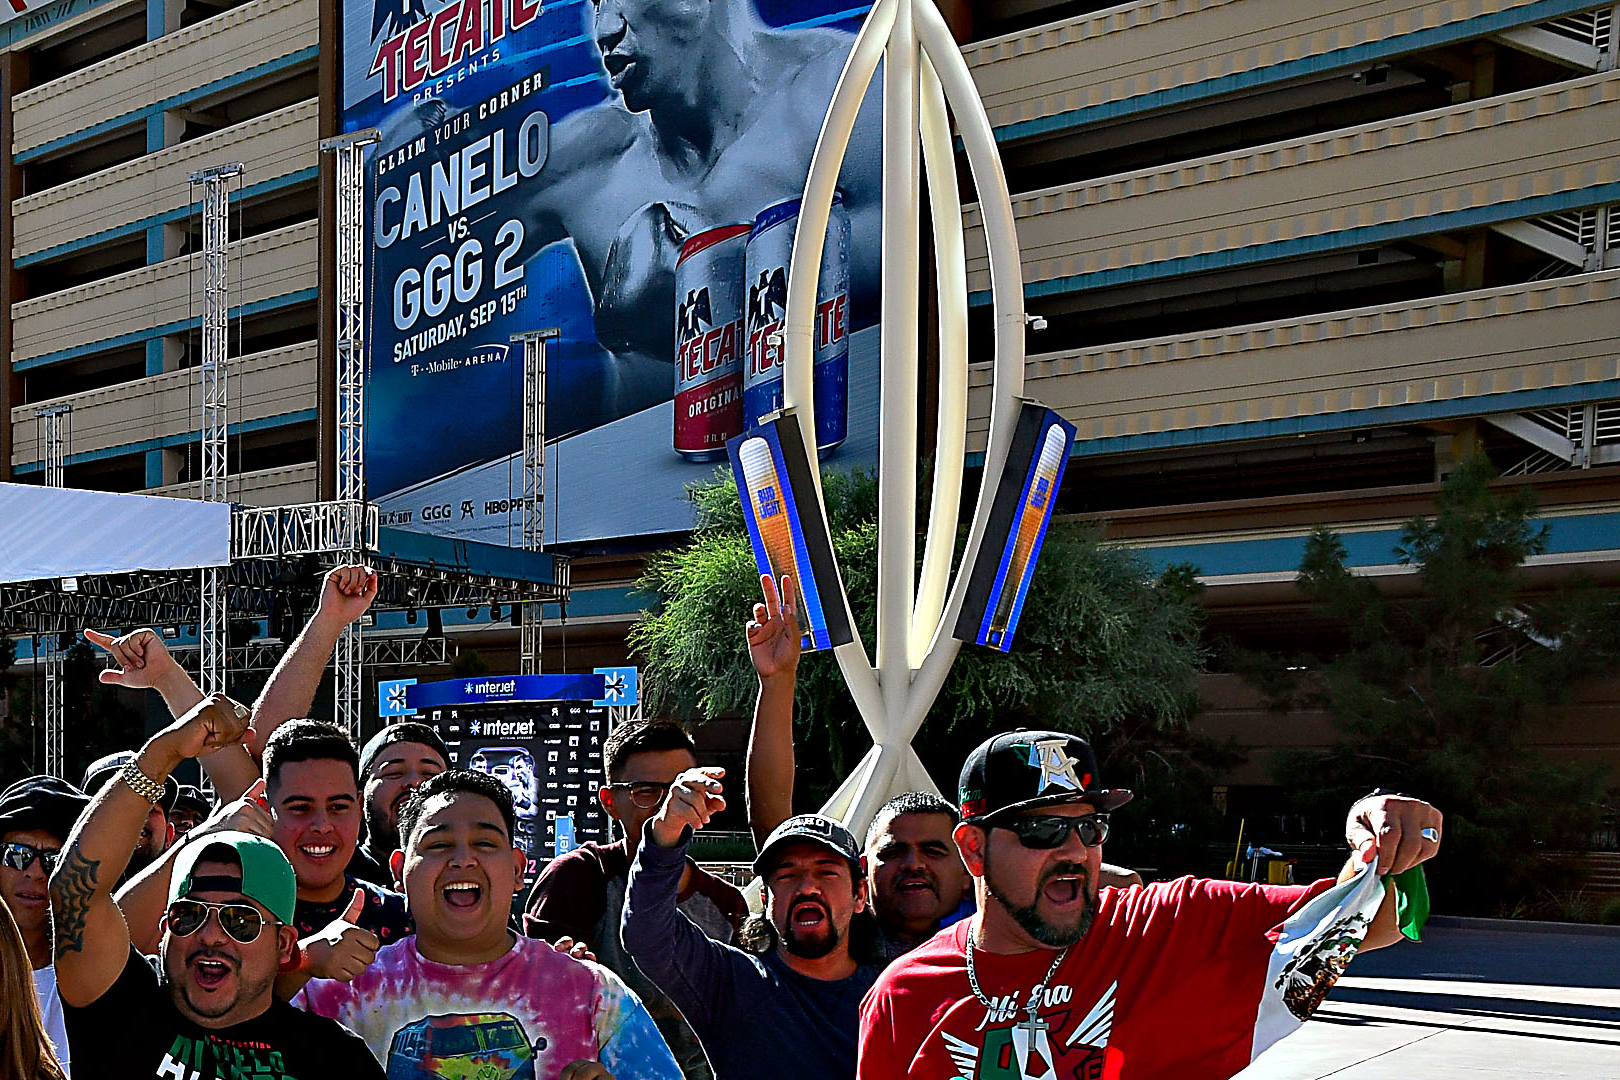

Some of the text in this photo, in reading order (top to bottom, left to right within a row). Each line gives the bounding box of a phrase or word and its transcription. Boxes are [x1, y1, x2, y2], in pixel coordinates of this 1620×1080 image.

[413, 48, 500, 106] PRESENTS
[379, 72, 543, 175] CLAIM YOUR CORNER
[375, 110, 549, 249] CANELO
[448, 216, 471, 244] VS.
[393, 219, 525, 331] GGG 2
[393, 284, 528, 363] SATURDAY, SEP 15TH
[465, 351, 501, 367] ARENA
[421, 504, 451, 521] GGG
[975, 990, 1020, 1032] Mi
